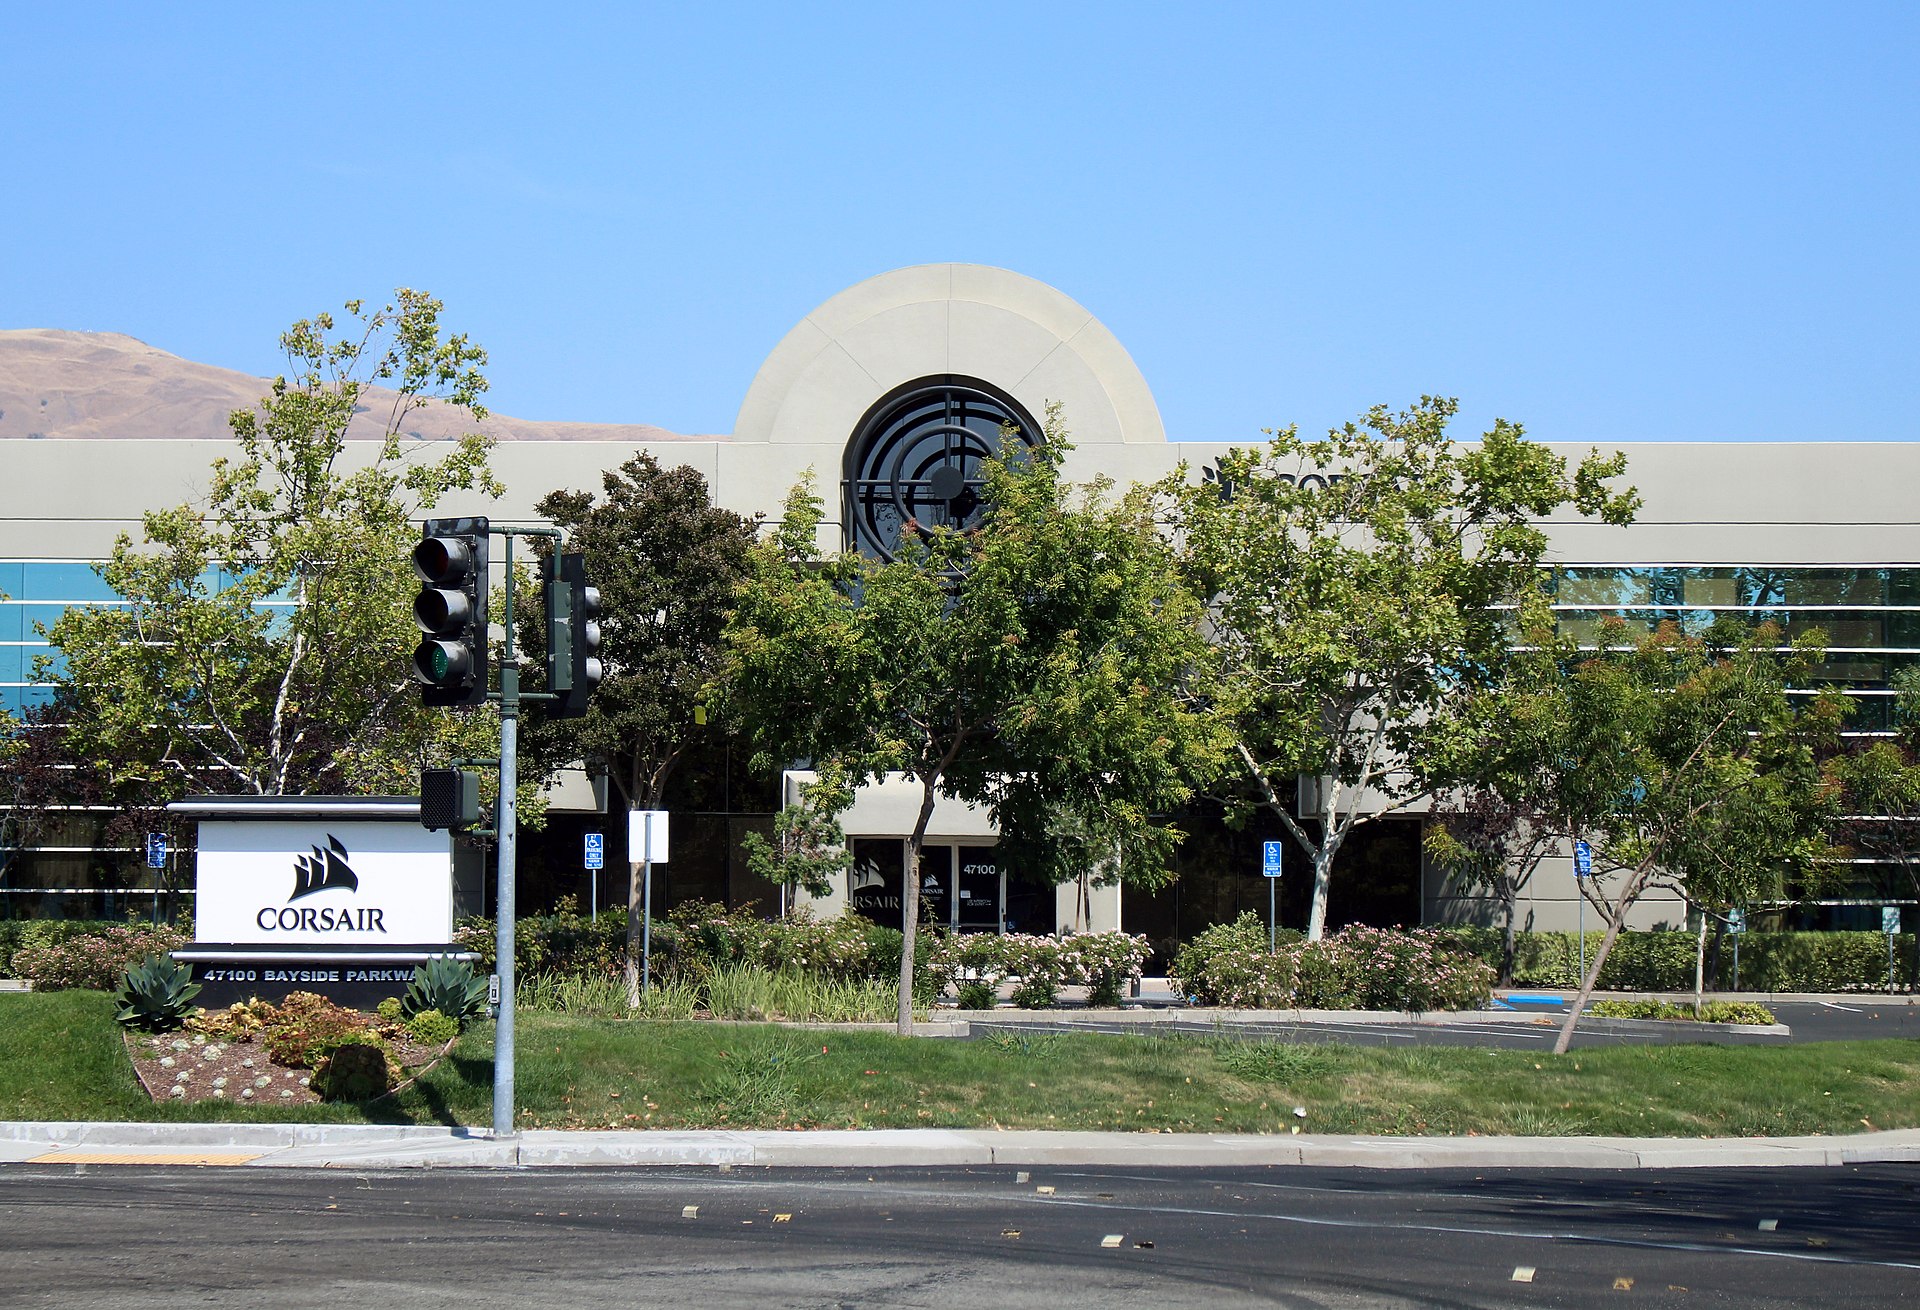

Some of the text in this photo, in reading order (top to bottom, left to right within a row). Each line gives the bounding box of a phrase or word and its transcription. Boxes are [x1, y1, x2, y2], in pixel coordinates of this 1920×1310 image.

[963, 865, 996, 875] 47100
[855, 896, 899, 909] RSAIR
[256, 907, 387, 933] CORSAIR
[204, 970, 416, 981] 47100 BAYSIDE PARKWA
